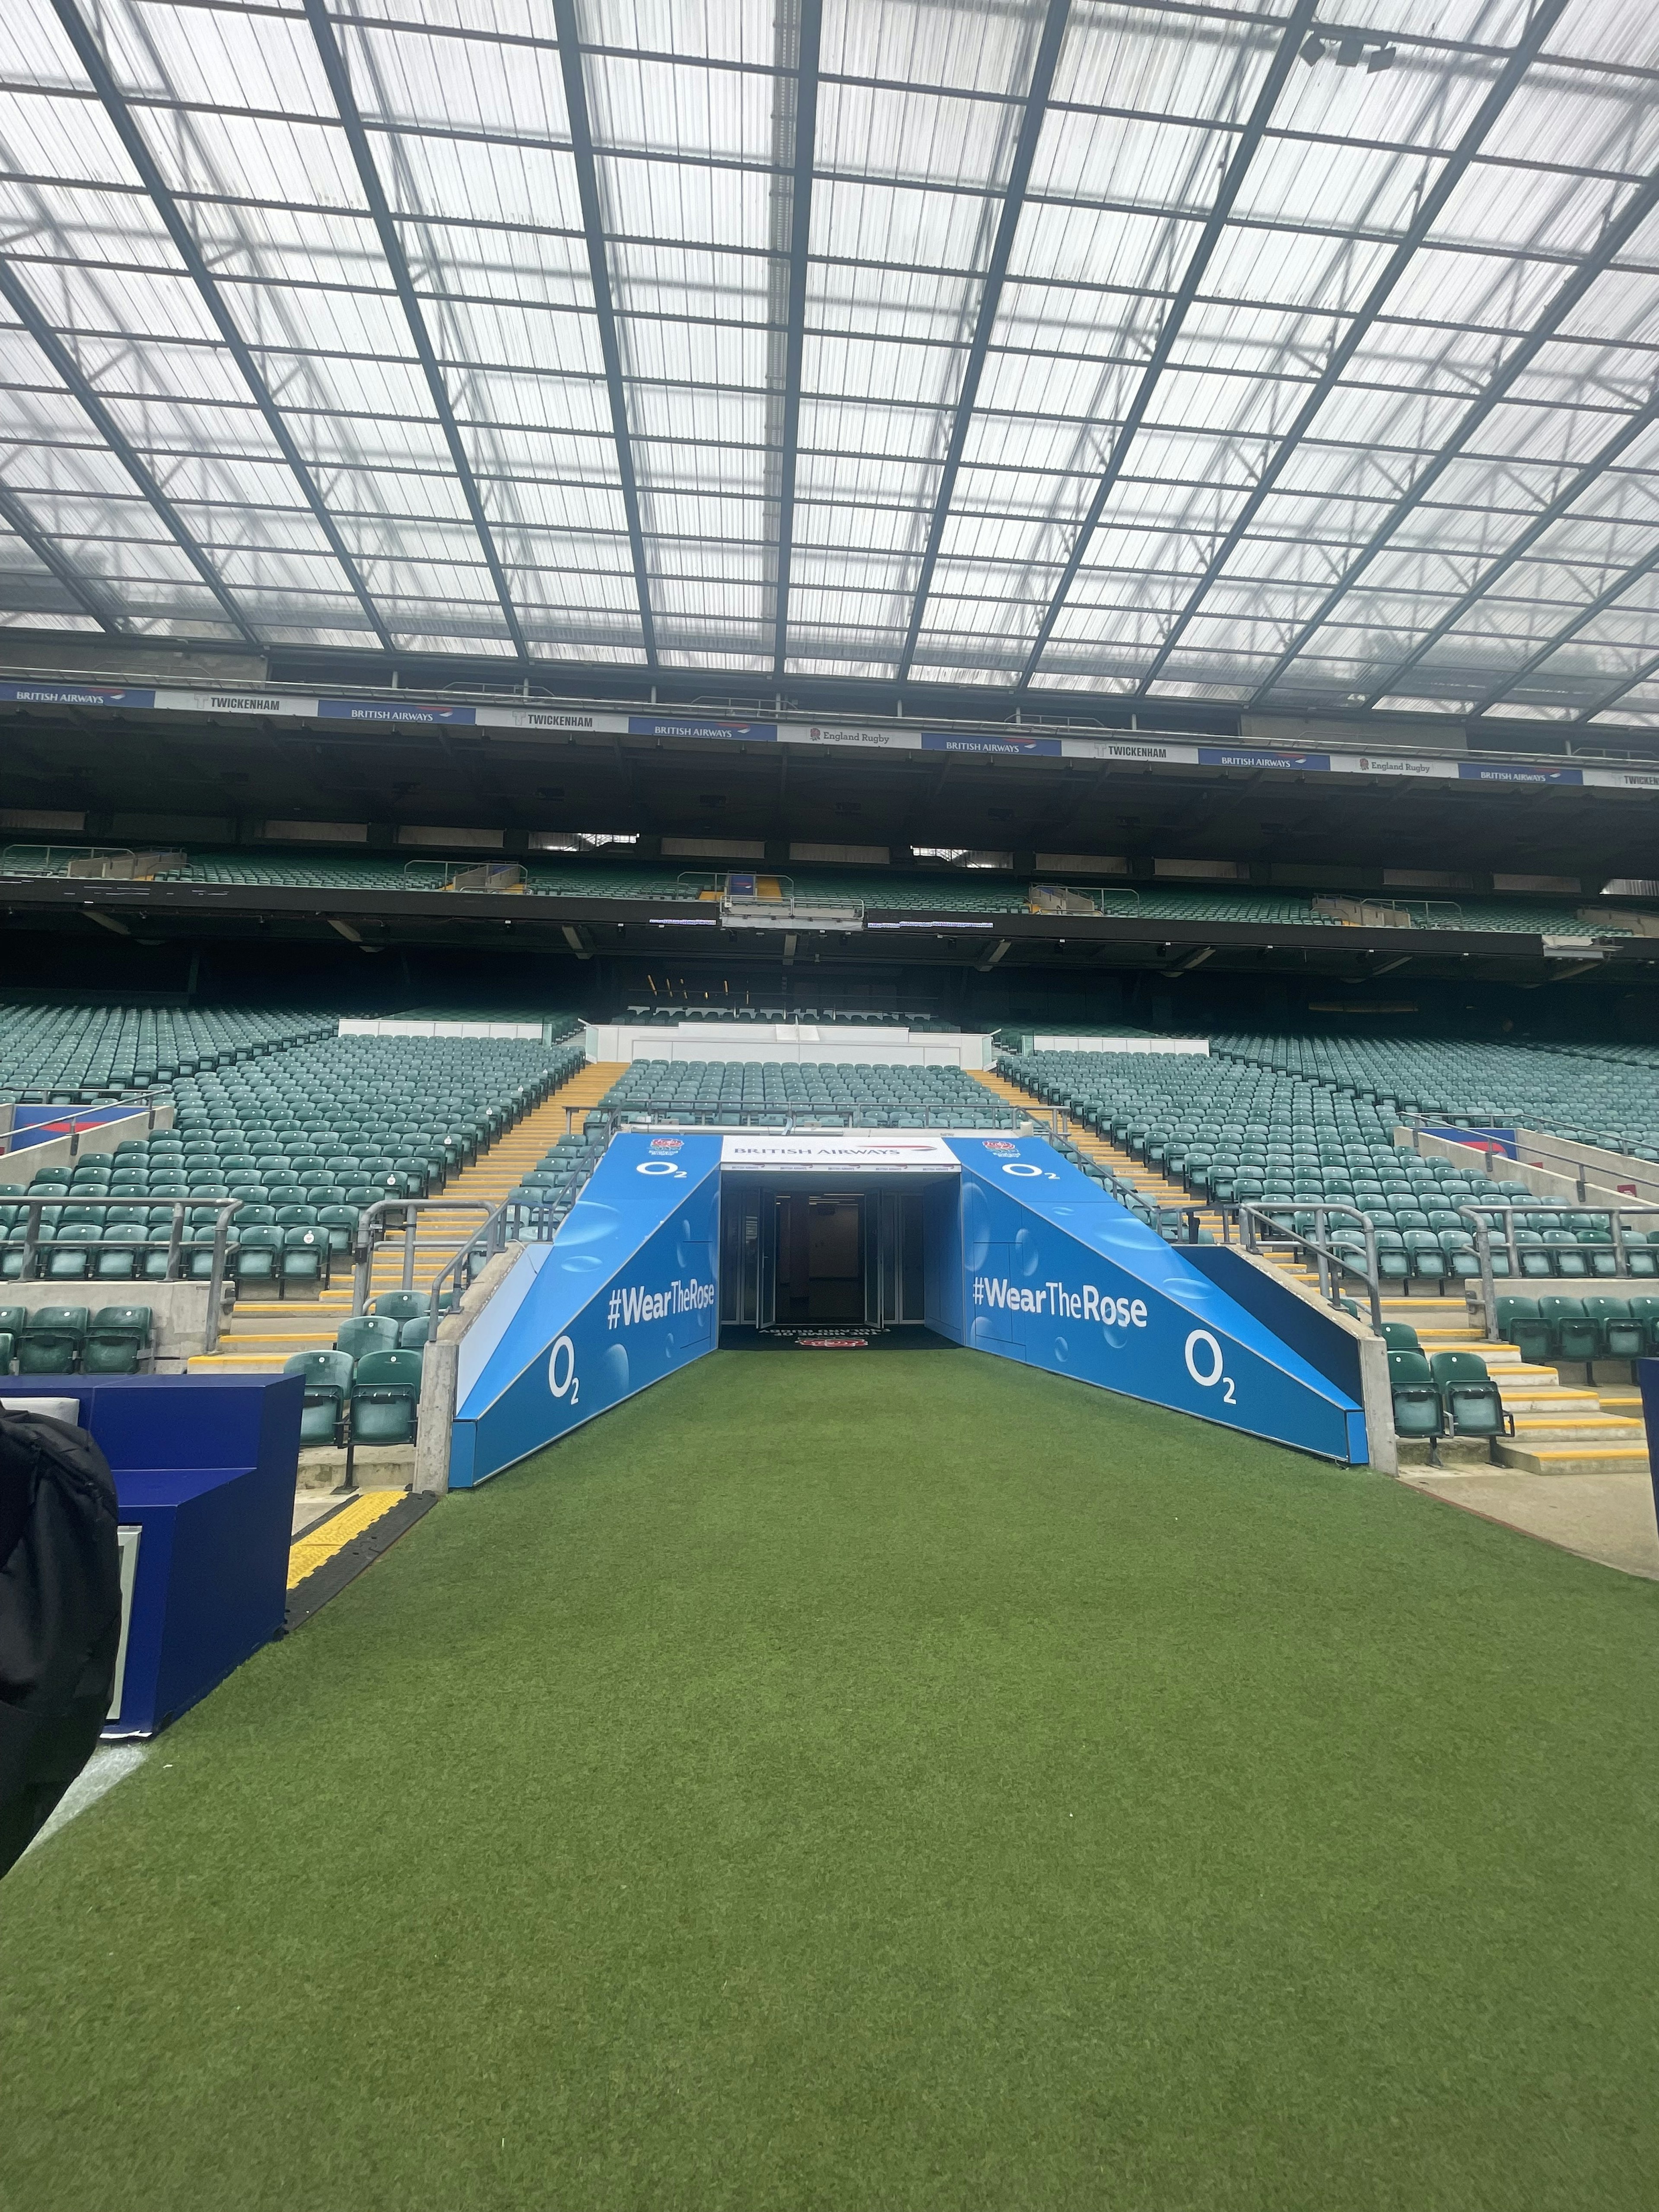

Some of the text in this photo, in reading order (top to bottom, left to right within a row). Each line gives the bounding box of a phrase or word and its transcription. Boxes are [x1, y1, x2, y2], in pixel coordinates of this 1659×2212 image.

[16, 691, 104, 704] BRITISH AIRWAYS
[211, 697, 280, 710] TWICKENHAM
[351, 710, 433, 721] BRITISH AIRWAYS
[528, 715, 593, 727] TWICKENHAM
[655, 726, 732, 738] BRITISH AIRWAYS
[823, 732, 890, 744] England Rugby
[946, 742, 1019, 753] BRITISH AIRWAYS
[1109, 746, 1166, 758] TWICKENHAM
[1222, 757, 1290, 767] BRITISH AIRWAYS
[1371, 762, 1430, 773] England Rugby
[1481, 772, 1512, 780] BRITISH
[607, 1278, 714, 1330] #WearTheRose
[972, 1277, 1147, 1327] #WearTheRose
